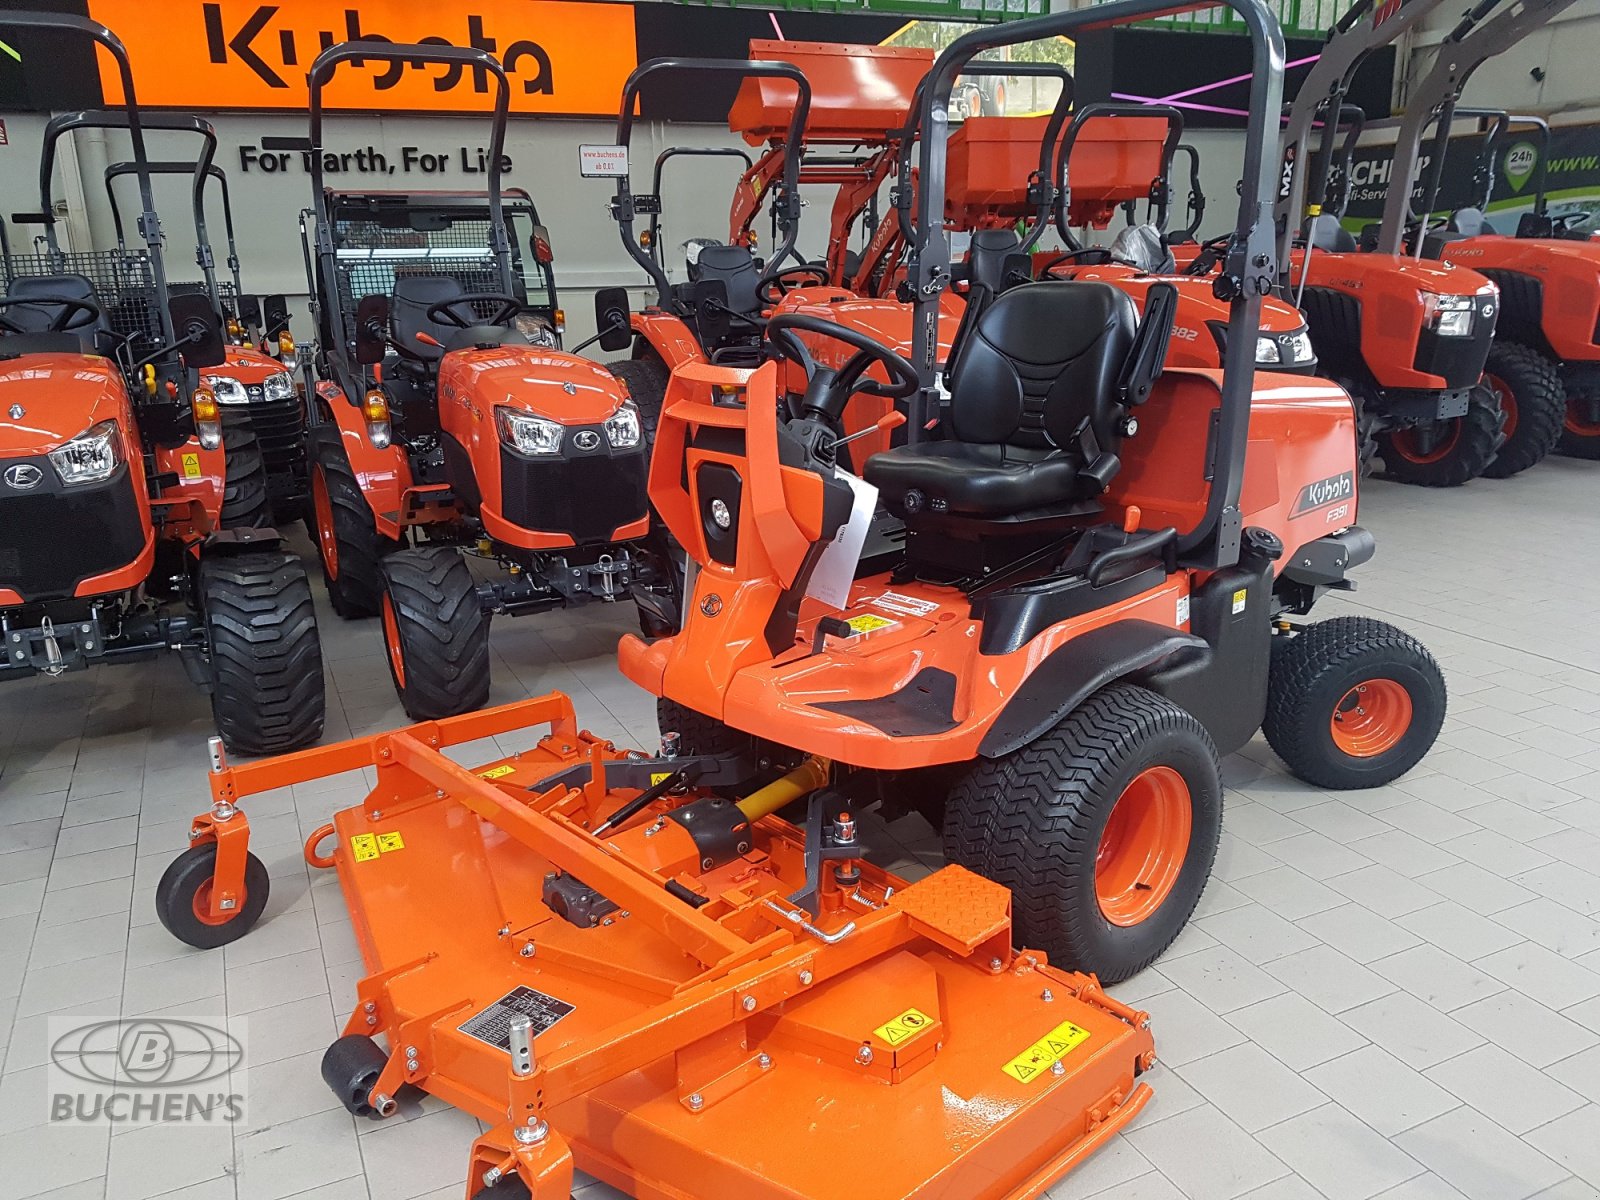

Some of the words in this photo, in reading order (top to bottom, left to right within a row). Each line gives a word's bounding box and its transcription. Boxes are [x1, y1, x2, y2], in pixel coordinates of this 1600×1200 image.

[203, 3, 555, 96] Kubota
[239, 146, 291, 172] For
[402, 147, 449, 173] For
[461, 147, 513, 174] Lie
[1510, 150, 1533, 163] 24h
[1280, 160, 1294, 196] MX
[871, 218, 892, 253] Kubota
[1309, 474, 1350, 505] Kubota
[1326, 503, 1349, 523] F391
